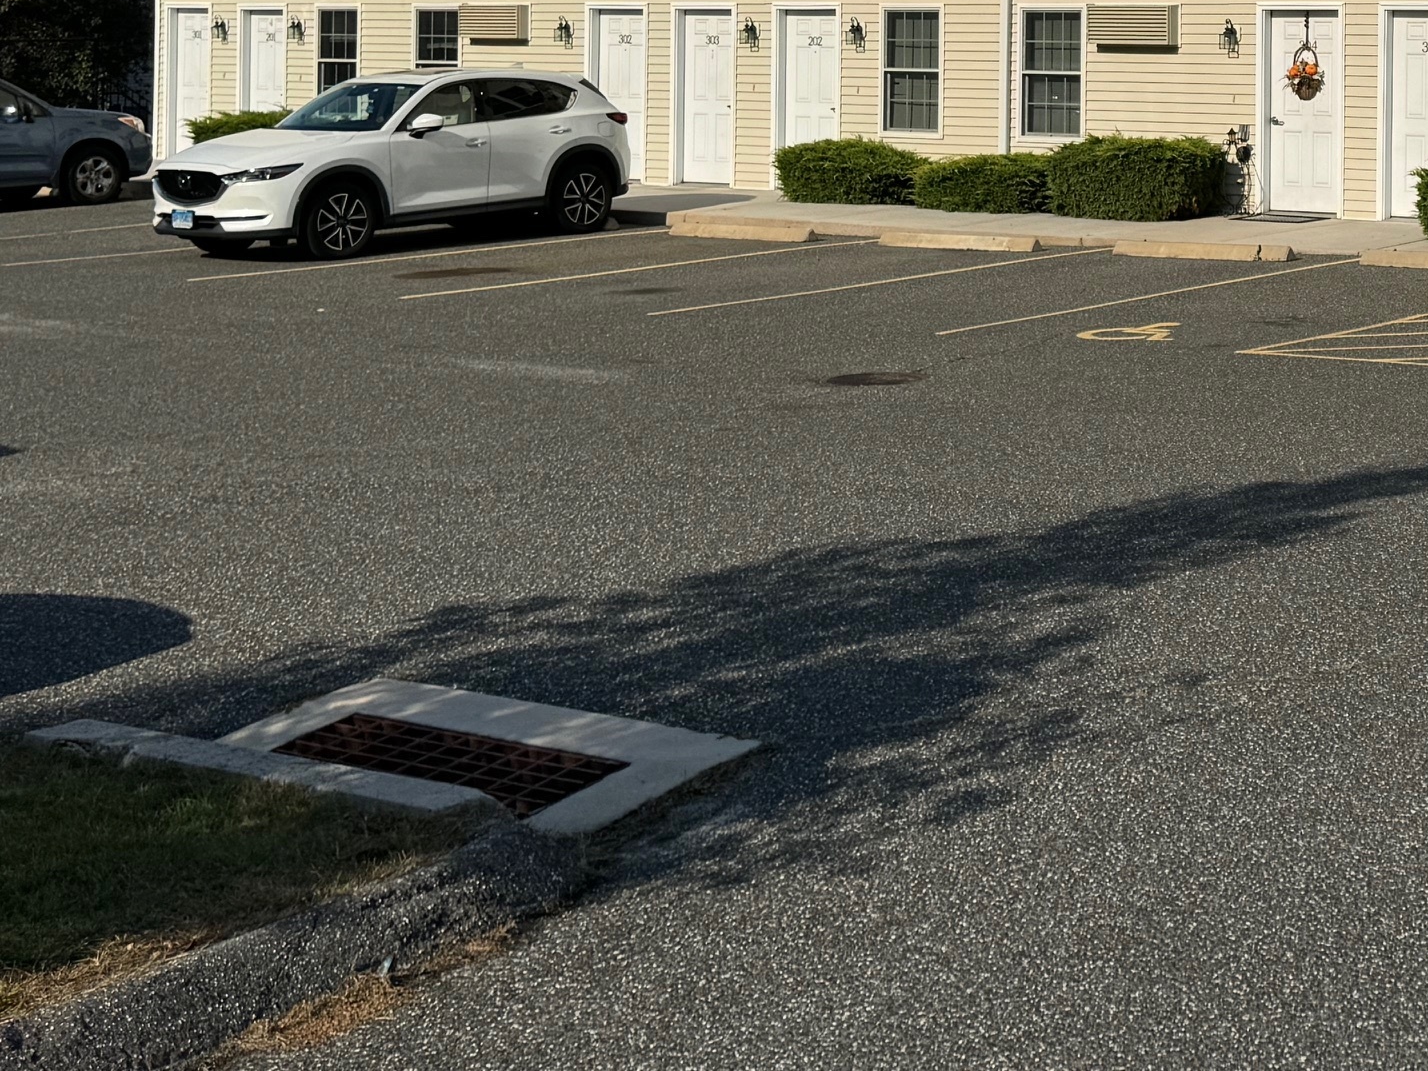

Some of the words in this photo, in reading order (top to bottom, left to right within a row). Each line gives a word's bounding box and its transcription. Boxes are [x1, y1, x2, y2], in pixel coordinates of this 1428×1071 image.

[618, 34, 632, 44] 302
[705, 35, 720, 45] 303
[808, 35, 823, 47] 202
